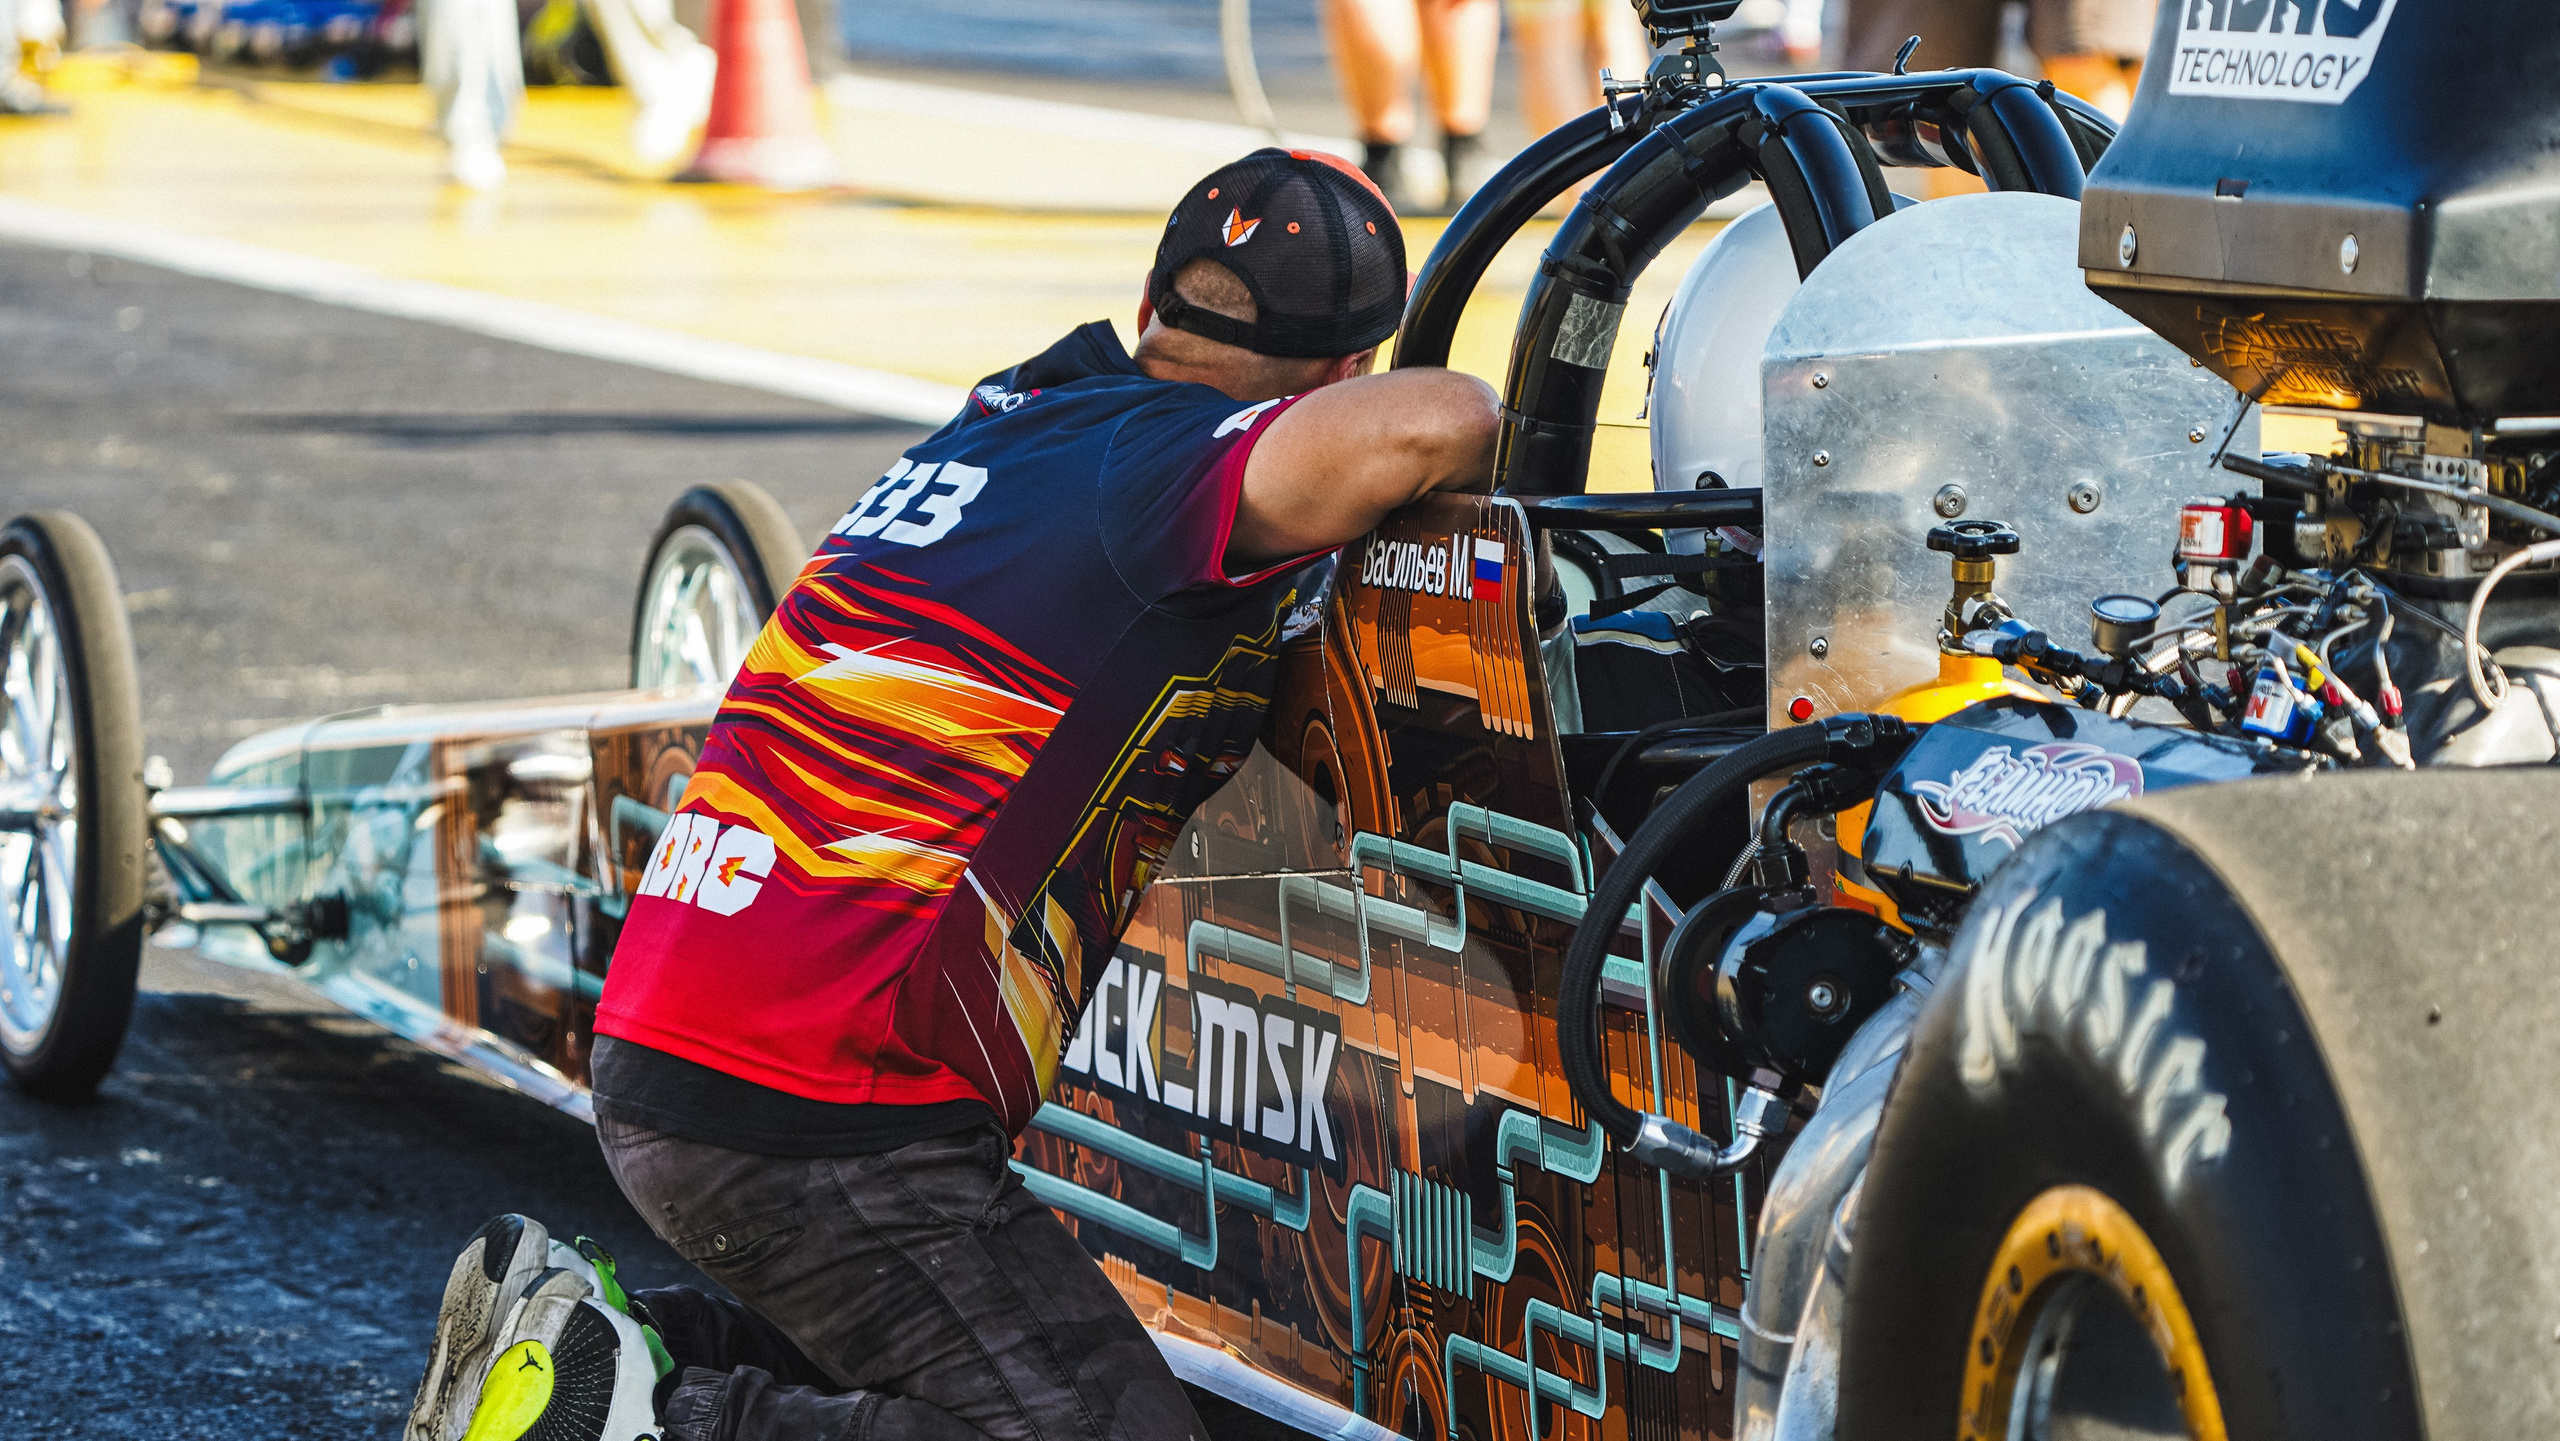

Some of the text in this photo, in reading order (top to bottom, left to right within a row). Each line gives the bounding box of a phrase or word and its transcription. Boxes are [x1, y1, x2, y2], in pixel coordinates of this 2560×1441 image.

[2178, 47, 2362, 91] TECHNOLOGY
[1360, 529, 1473, 600] Васильев М.
